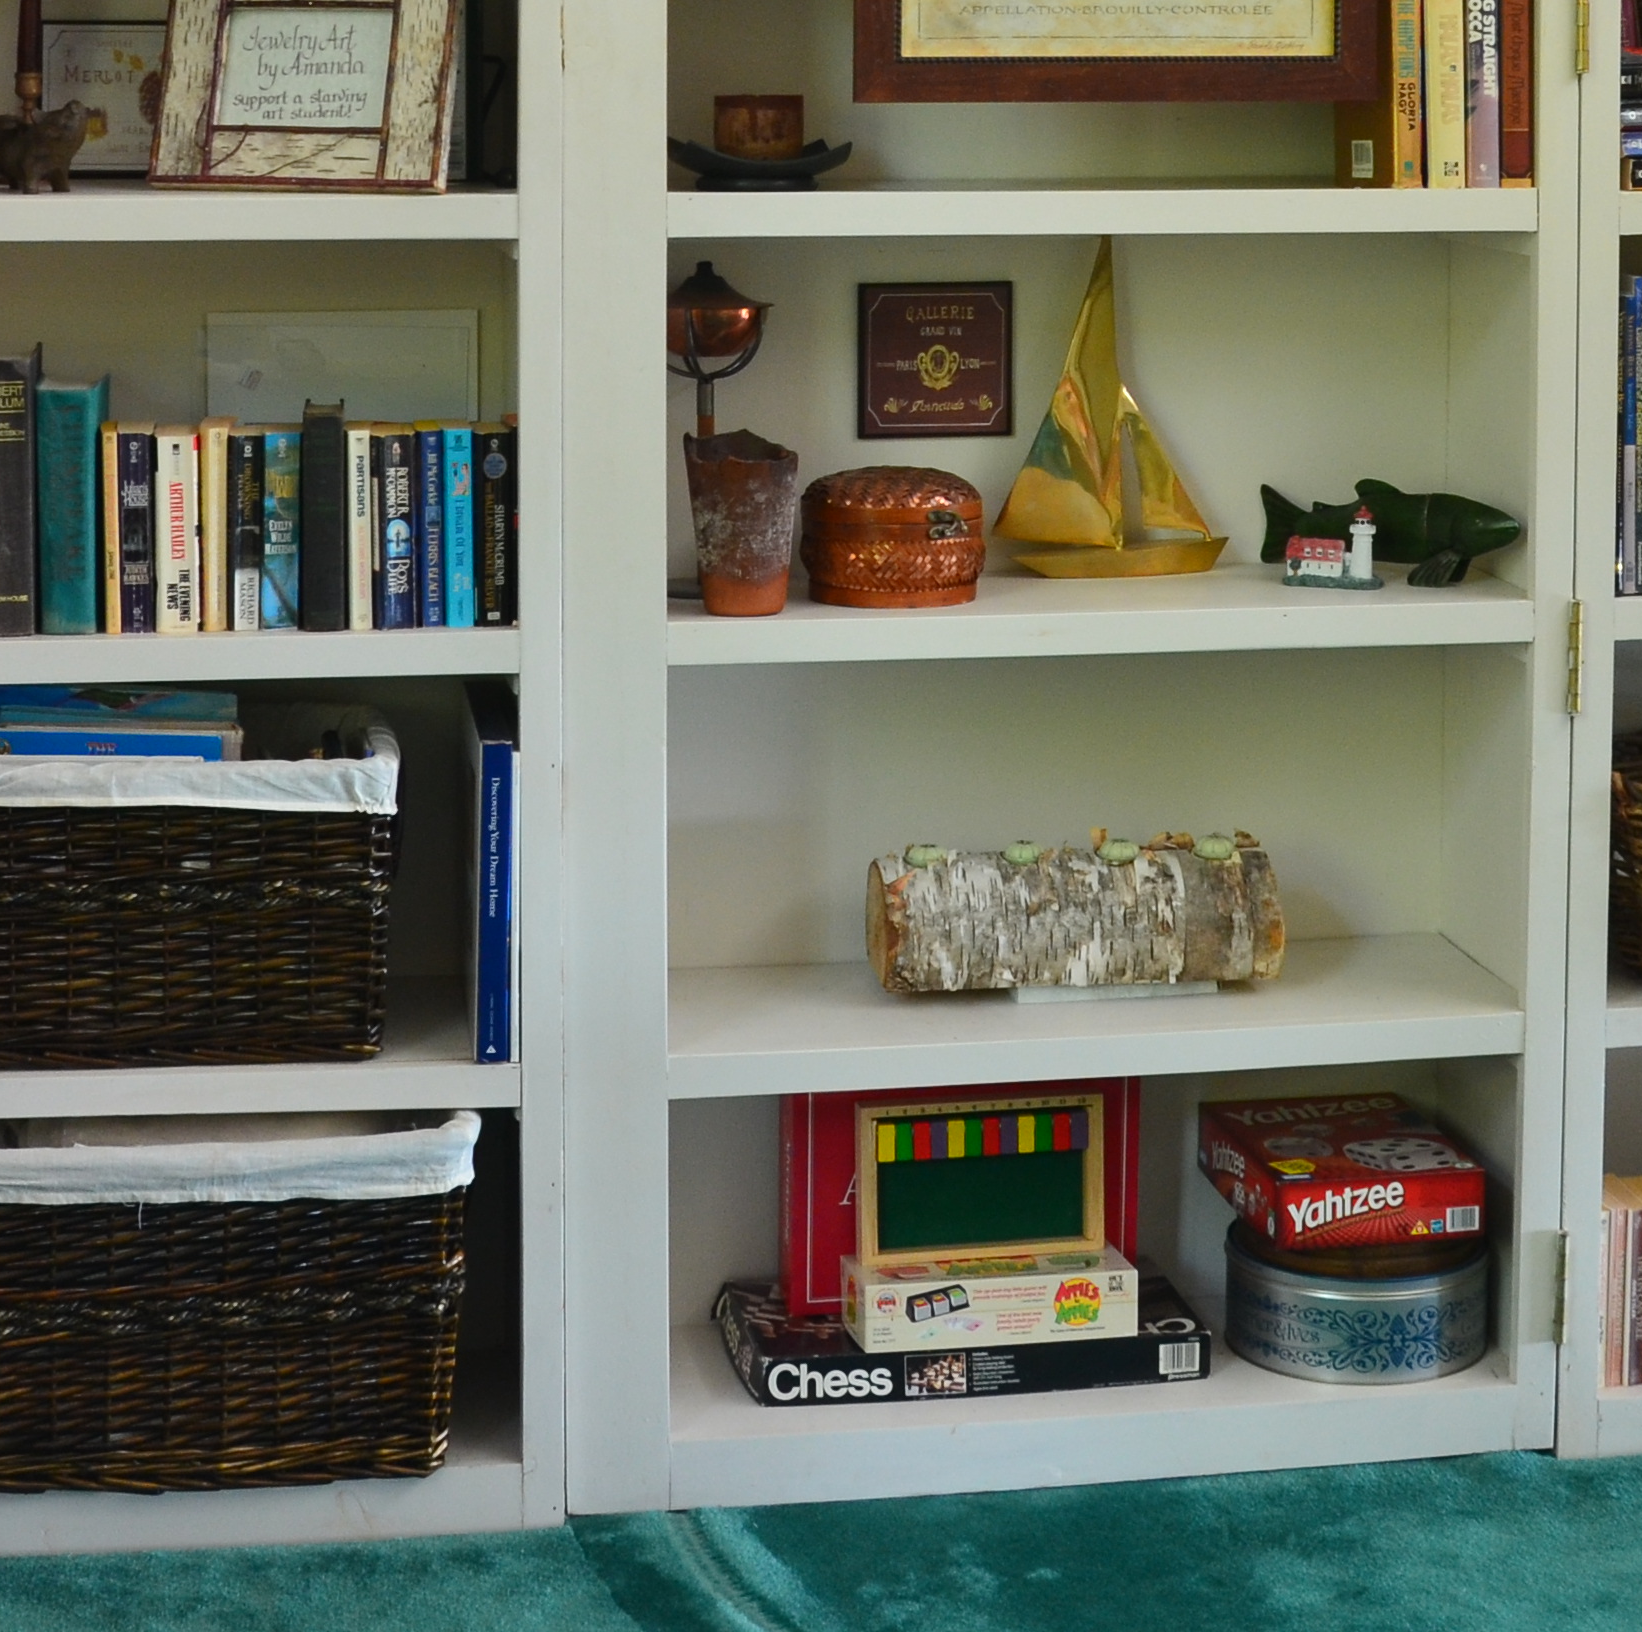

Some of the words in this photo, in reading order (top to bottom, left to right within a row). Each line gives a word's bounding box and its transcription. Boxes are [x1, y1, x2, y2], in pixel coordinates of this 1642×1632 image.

[243, 26, 317, 59] Jewelry
[320, 24, 357, 51] Art
[1482, 13, 1496, 98] STRAIGHT
[64, 65, 133, 84] MERLOT
[258, 52, 278, 90] by
[282, 51, 364, 76] Amanda
[234, 91, 287, 112] support
[310, 88, 367, 111] starving
[263, 109, 283, 120] art
[290, 105, 352, 119] student!
[487, 778, 502, 829] Discovering
[488, 831, 500, 853] Your
[488, 855, 500, 886] Dream
[488, 889, 500, 917] Home
[1232, 1101, 1396, 1127] Yahtzee
[1287, 1180, 1405, 1233] Yahtzee
[767, 1359, 892, 1403] Chess
